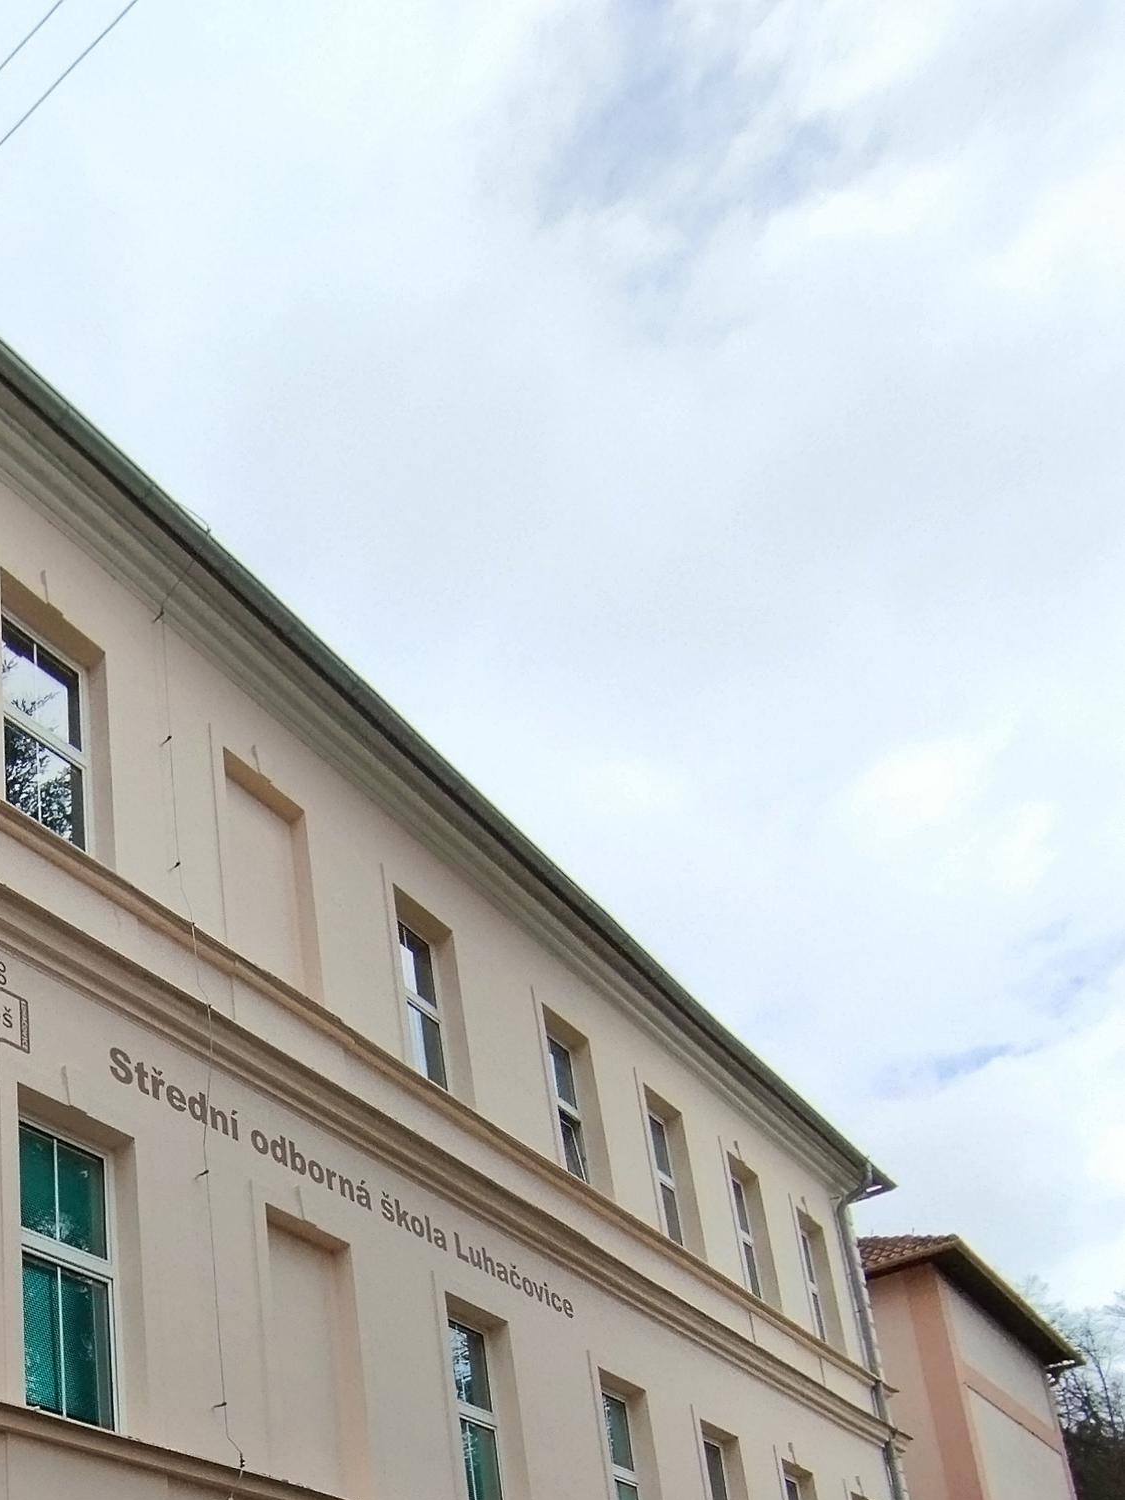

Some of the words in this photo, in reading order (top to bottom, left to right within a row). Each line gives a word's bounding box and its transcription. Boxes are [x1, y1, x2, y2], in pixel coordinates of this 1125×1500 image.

[109, 1047, 239, 1141] Střední
[251, 1127, 372, 1211] odborná
[381, 1191, 448, 1251] škola
[453, 1232, 575, 1319] Luhačovice
